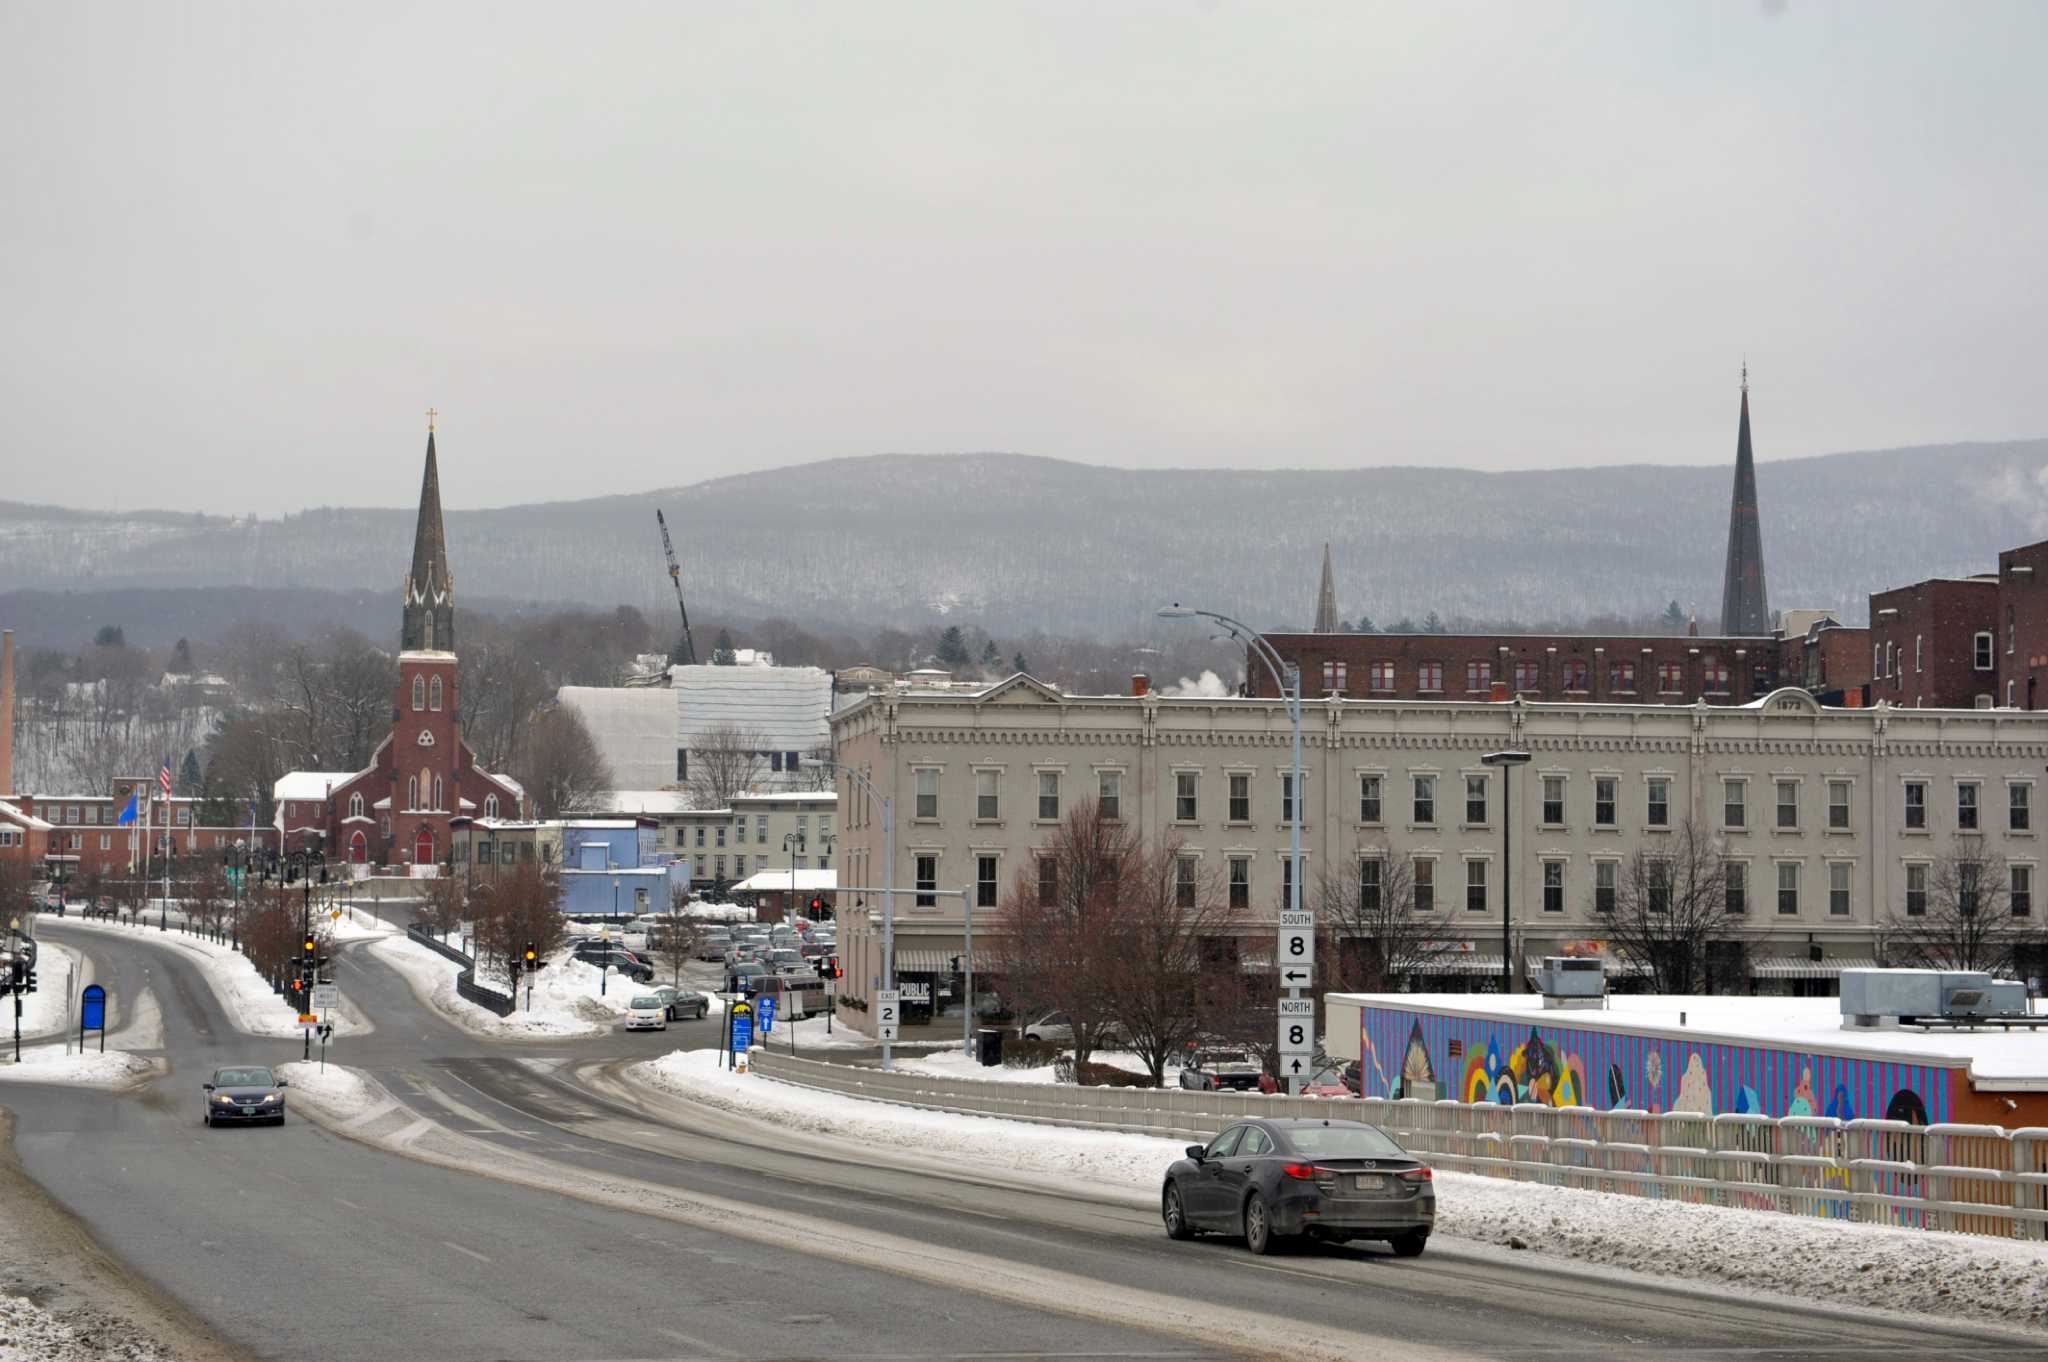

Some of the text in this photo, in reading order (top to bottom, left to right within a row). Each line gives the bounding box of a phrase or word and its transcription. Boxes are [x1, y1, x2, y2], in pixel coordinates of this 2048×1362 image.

[1282, 914, 1311, 924] SOUTH
[1290, 936, 1305, 956] 8
[900, 983, 930, 996] PUBLIC
[882, 1007, 893, 1020] 2
[1281, 1002, 1310, 1013] NORTH
[1289, 1025, 1304, 1045] 8
